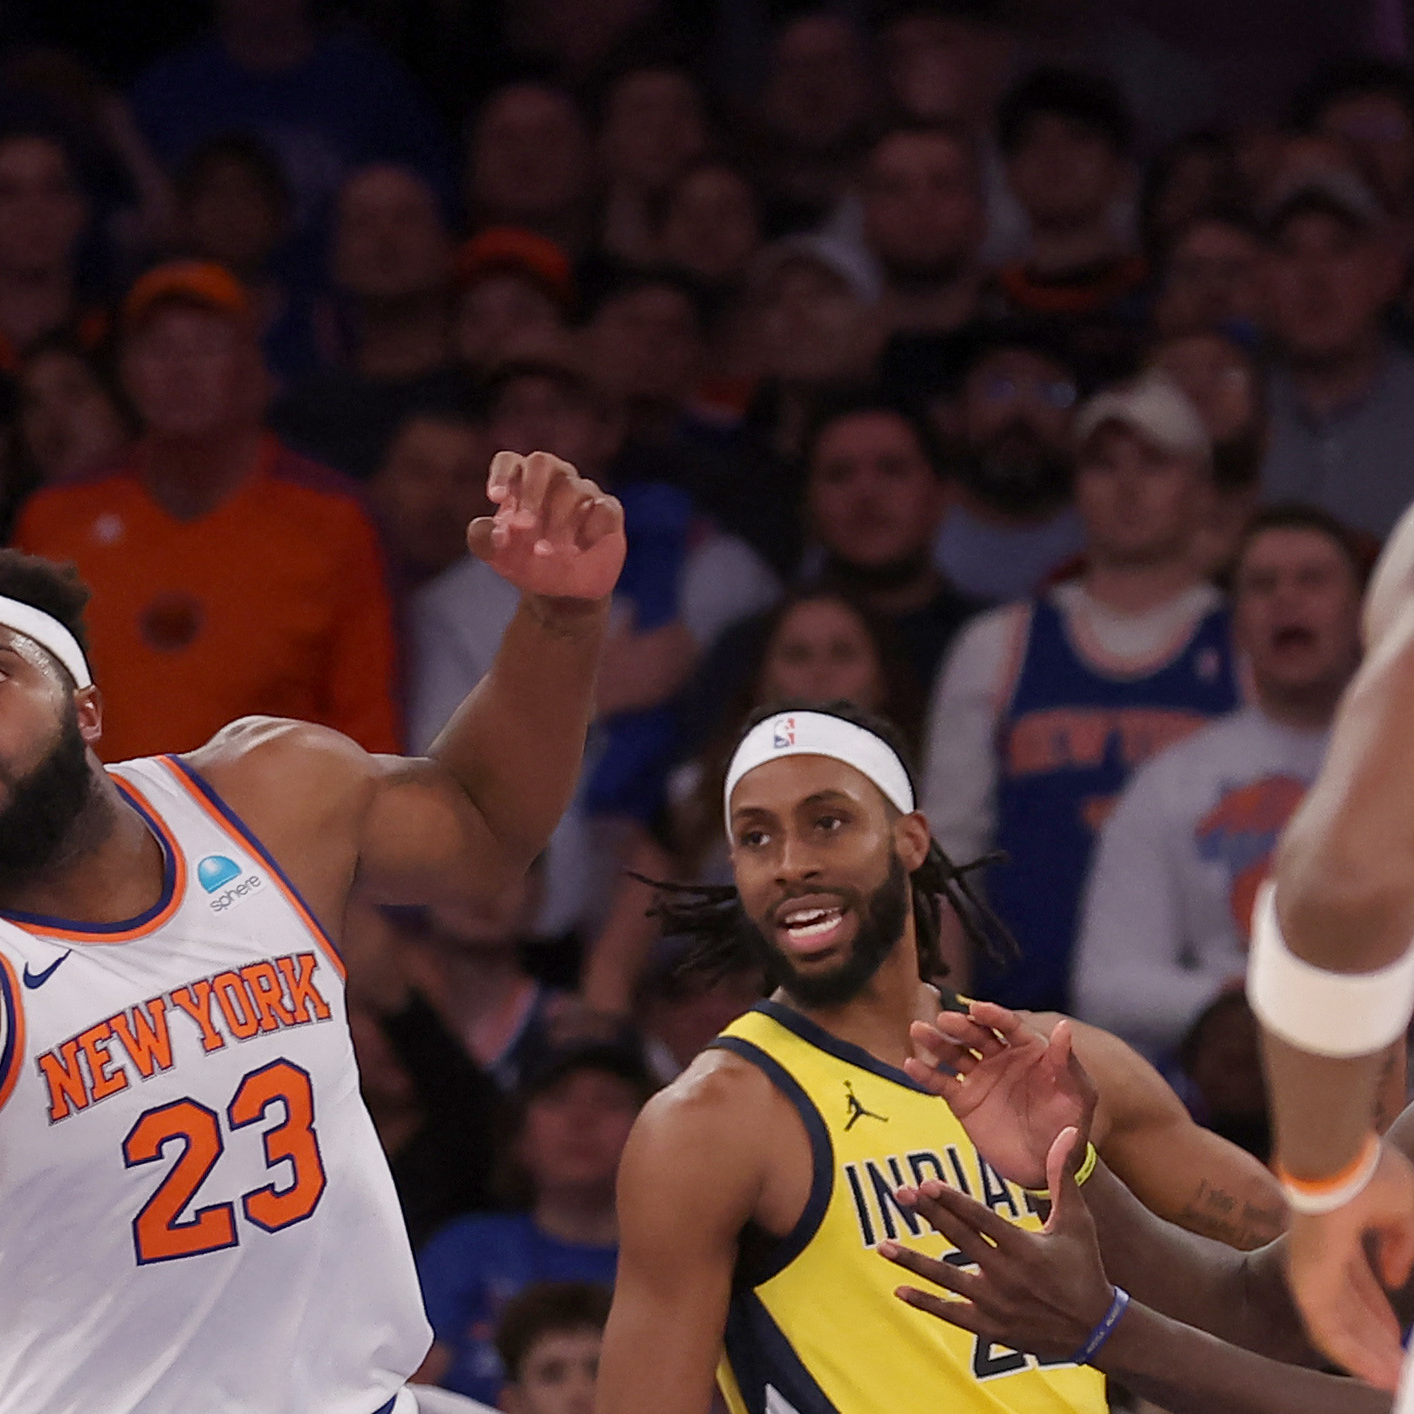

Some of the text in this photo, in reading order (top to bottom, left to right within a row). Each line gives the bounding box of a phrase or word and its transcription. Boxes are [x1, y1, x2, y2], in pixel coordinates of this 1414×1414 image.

[209, 874, 262, 913] sphere
[35, 950, 333, 1126] NEW YORK
[121, 1056, 328, 1267] 23
